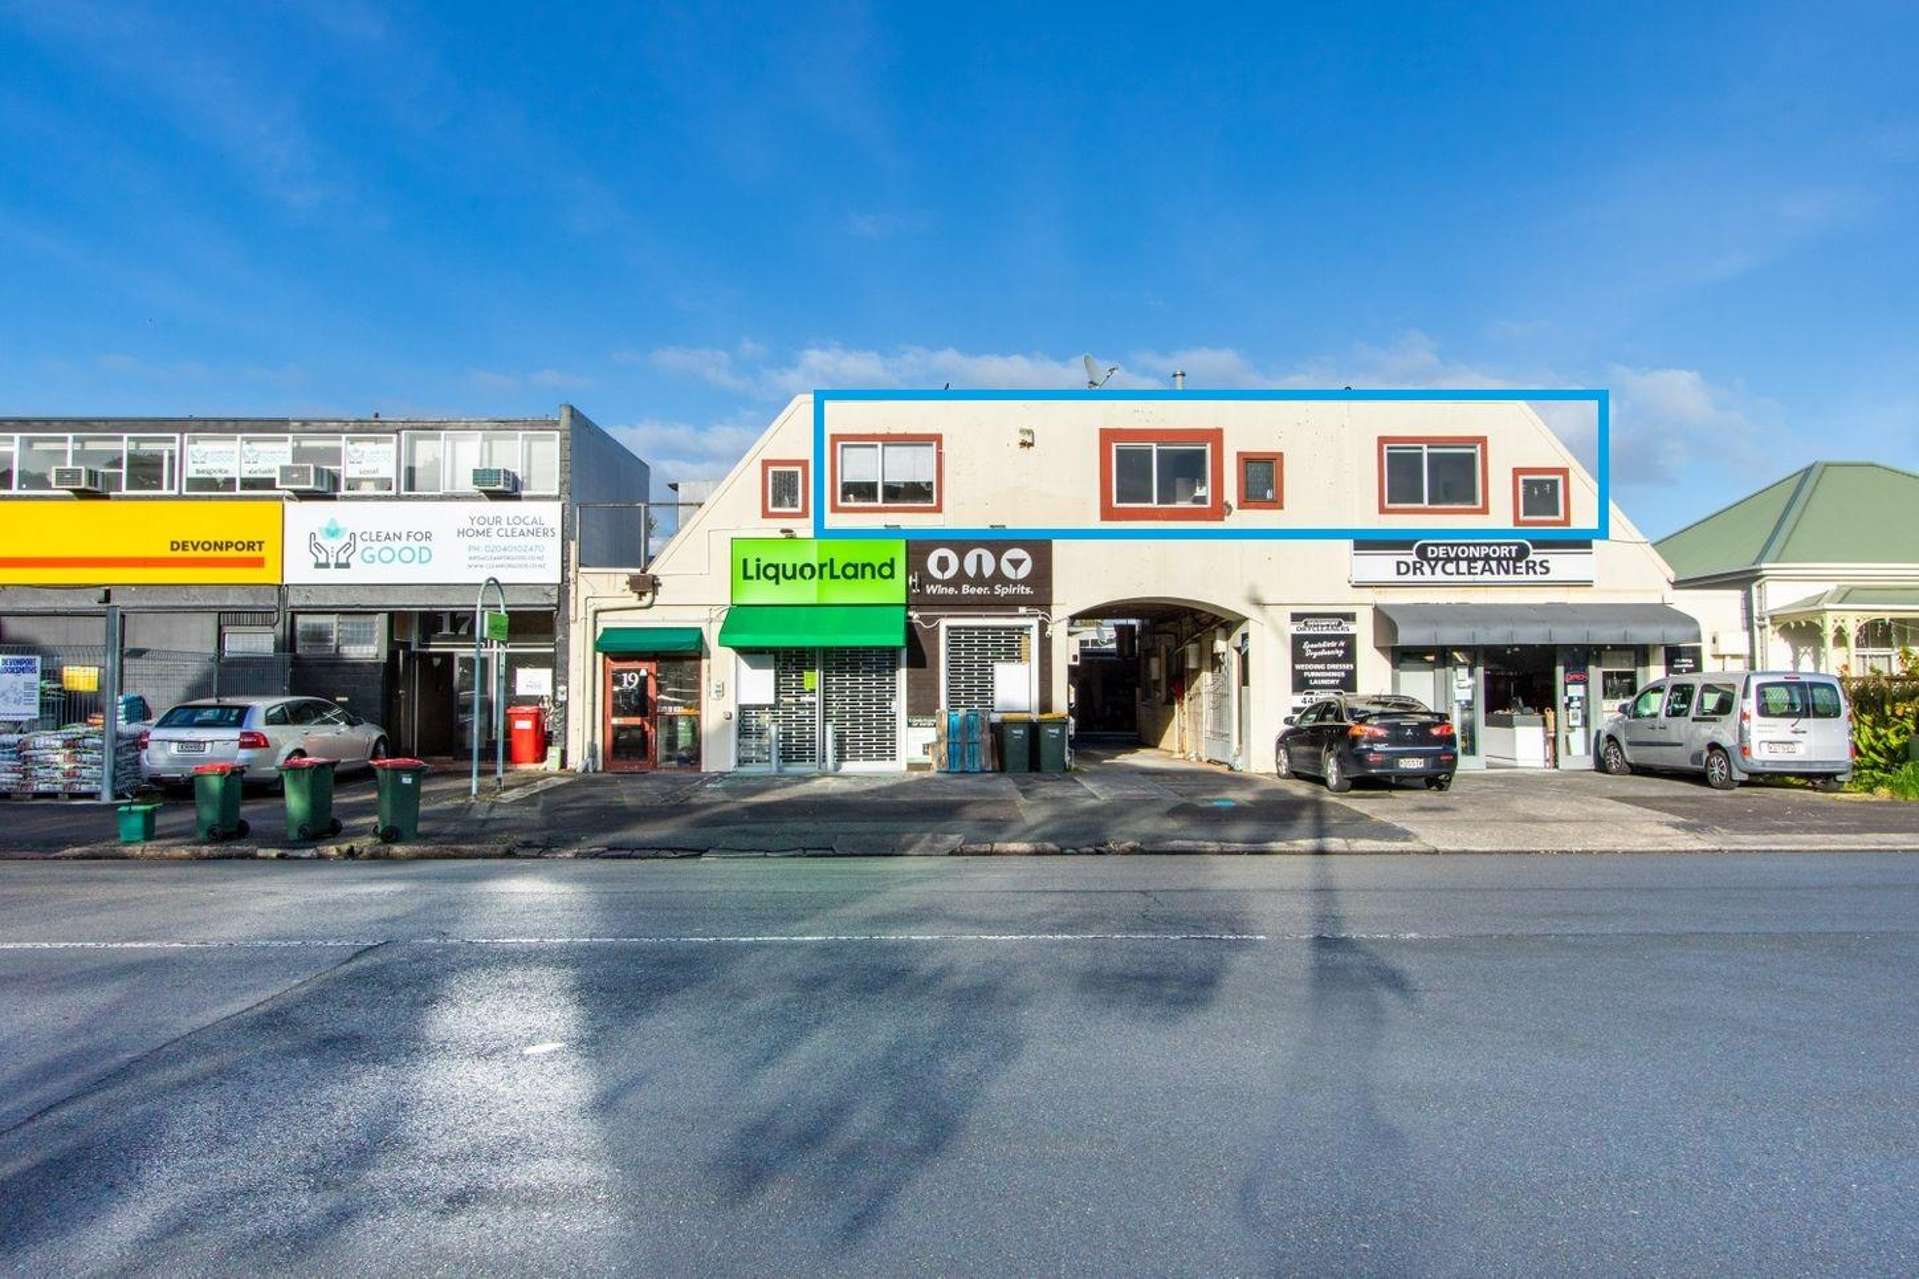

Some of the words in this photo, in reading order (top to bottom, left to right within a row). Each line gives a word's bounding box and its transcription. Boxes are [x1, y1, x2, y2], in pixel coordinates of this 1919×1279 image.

[469, 515, 502, 526] YOUR
[506, 515, 545, 526] LOCAL
[360, 531, 402, 542] CLEAN
[406, 531, 433, 542] FOR
[457, 527, 493, 538] HOME
[496, 527, 556, 538] CLEANERS
[170, 540, 265, 552] DEVONPORT
[1427, 546, 1519, 558] DEVONPORT
[361, 546, 433, 564] GOOD
[742, 557, 895, 585] LiquorLand
[1395, 559, 1551, 576] DRYCLEANERS
[926, 584, 958, 595] Wine.
[962, 584, 991, 595] Beer.
[994, 584, 1034, 597] Spirits.
[437, 612, 473, 636] 17
[621, 672, 640, 689] 19
